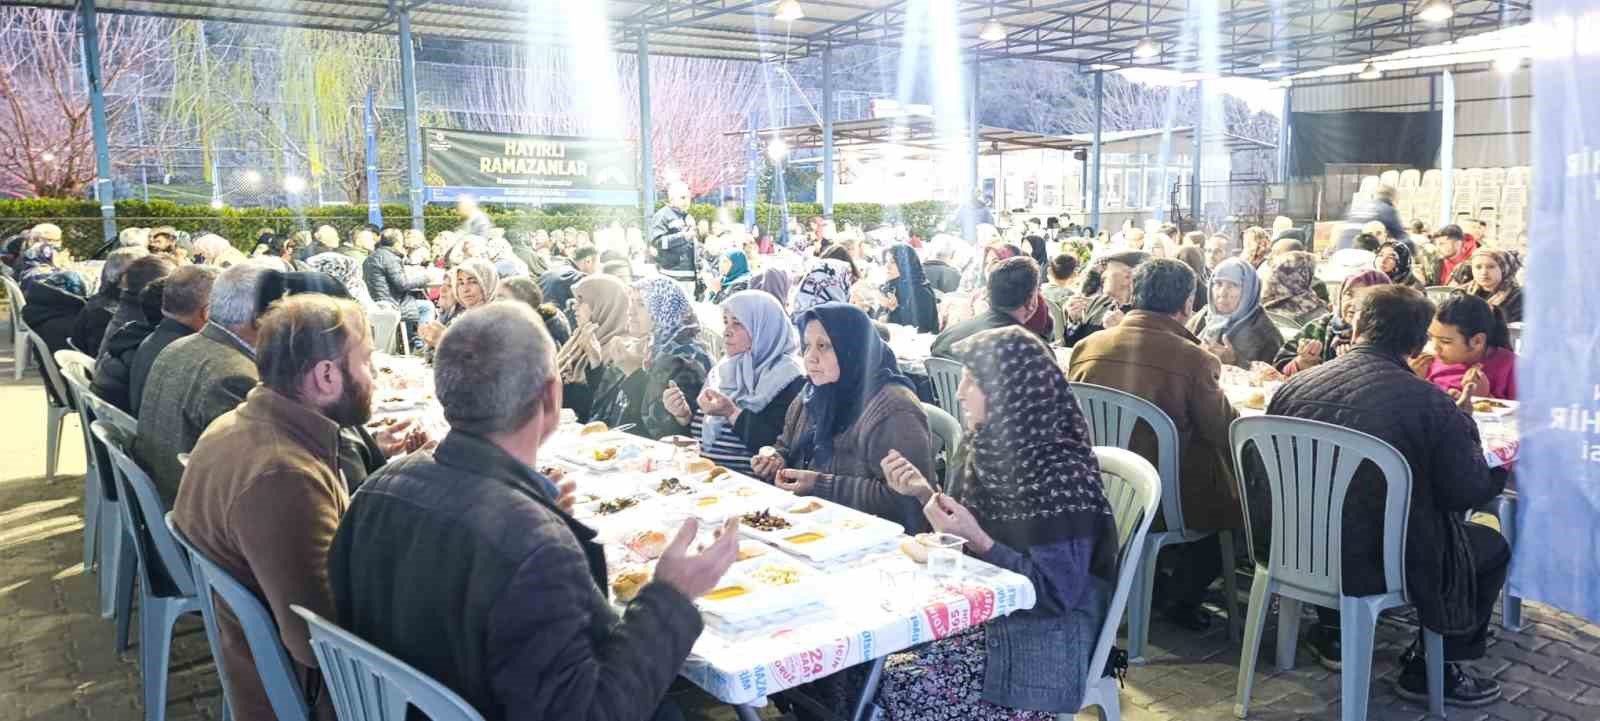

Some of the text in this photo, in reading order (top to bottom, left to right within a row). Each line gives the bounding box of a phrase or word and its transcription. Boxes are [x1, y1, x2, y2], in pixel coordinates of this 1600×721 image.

[505, 140, 565, 157] HAYIRLI
[480, 156, 587, 176] RAMAZANLAR
[808, 648, 824, 675] 24
